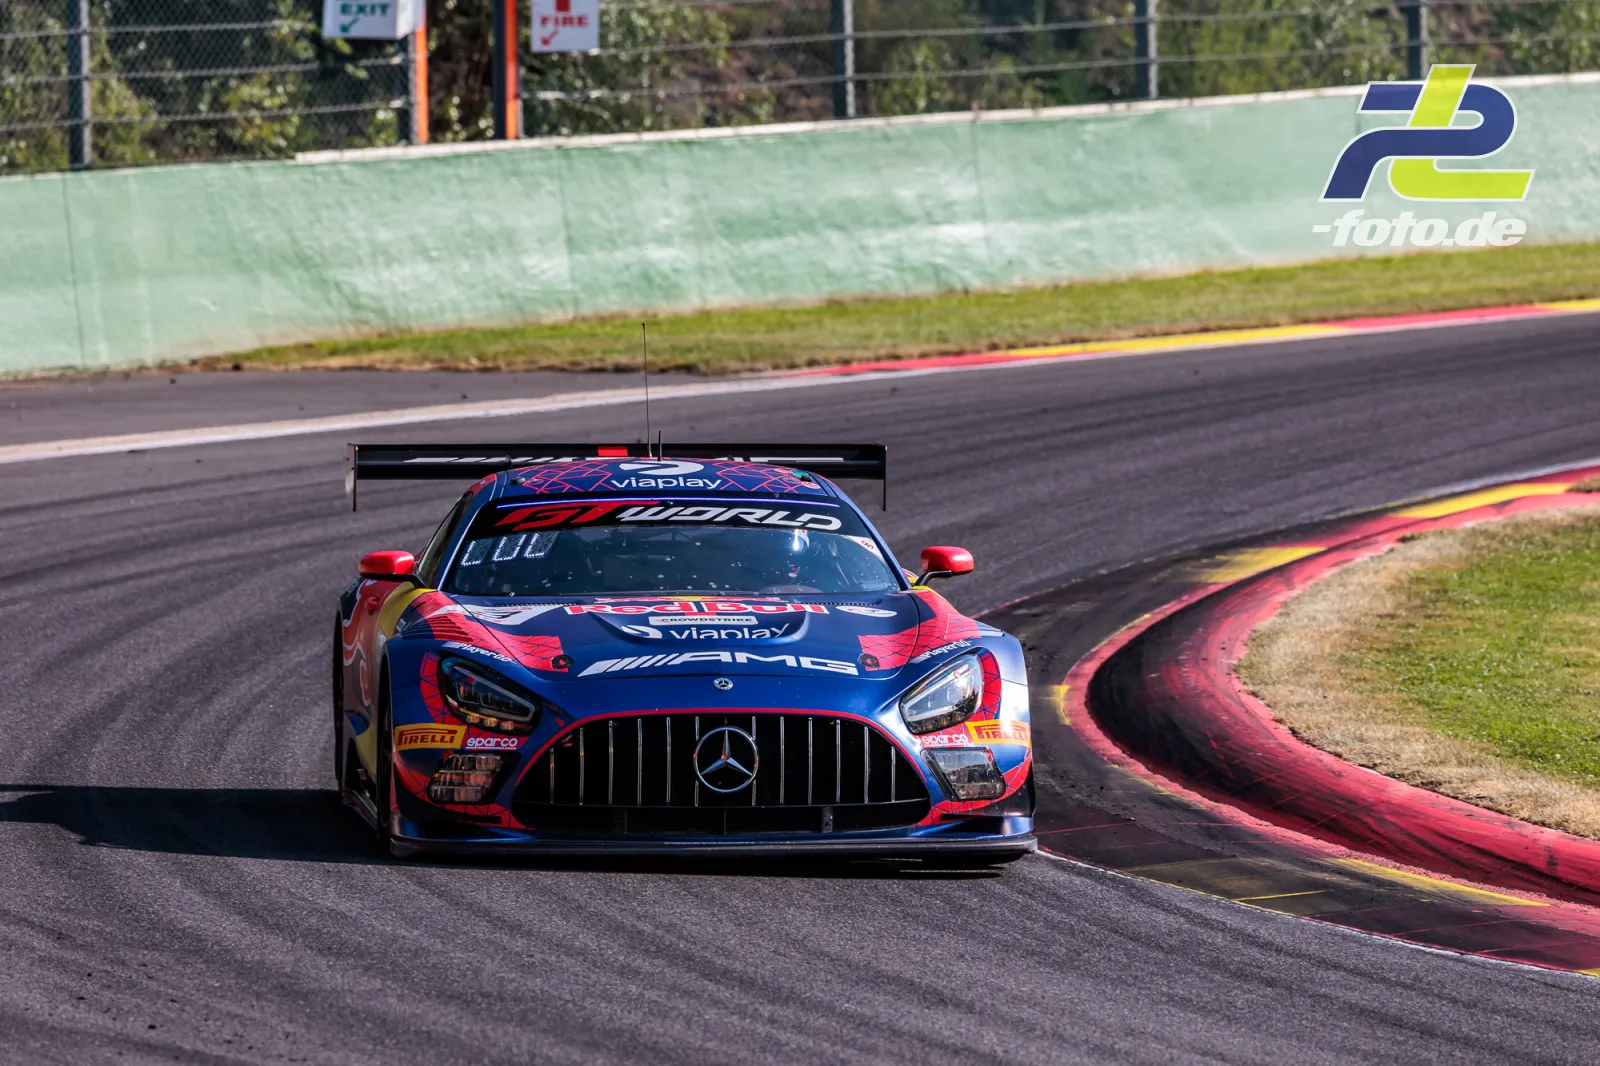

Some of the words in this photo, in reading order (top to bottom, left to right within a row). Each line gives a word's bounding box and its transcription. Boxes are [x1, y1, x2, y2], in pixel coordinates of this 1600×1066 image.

[340, 2, 391, 17] EXIT
[540, 15, 590, 28] FIRE
[610, 476, 722, 492] viaplay
[616, 506, 842, 531] WORLD
[565, 602, 694, 616] Red
[698, 602, 830, 616] Bull
[670, 651, 859, 675] AMG
[397, 727, 458, 747] PIRELLI
[465, 737, 519, 749] sparco
[921, 733, 969, 747] sparco
